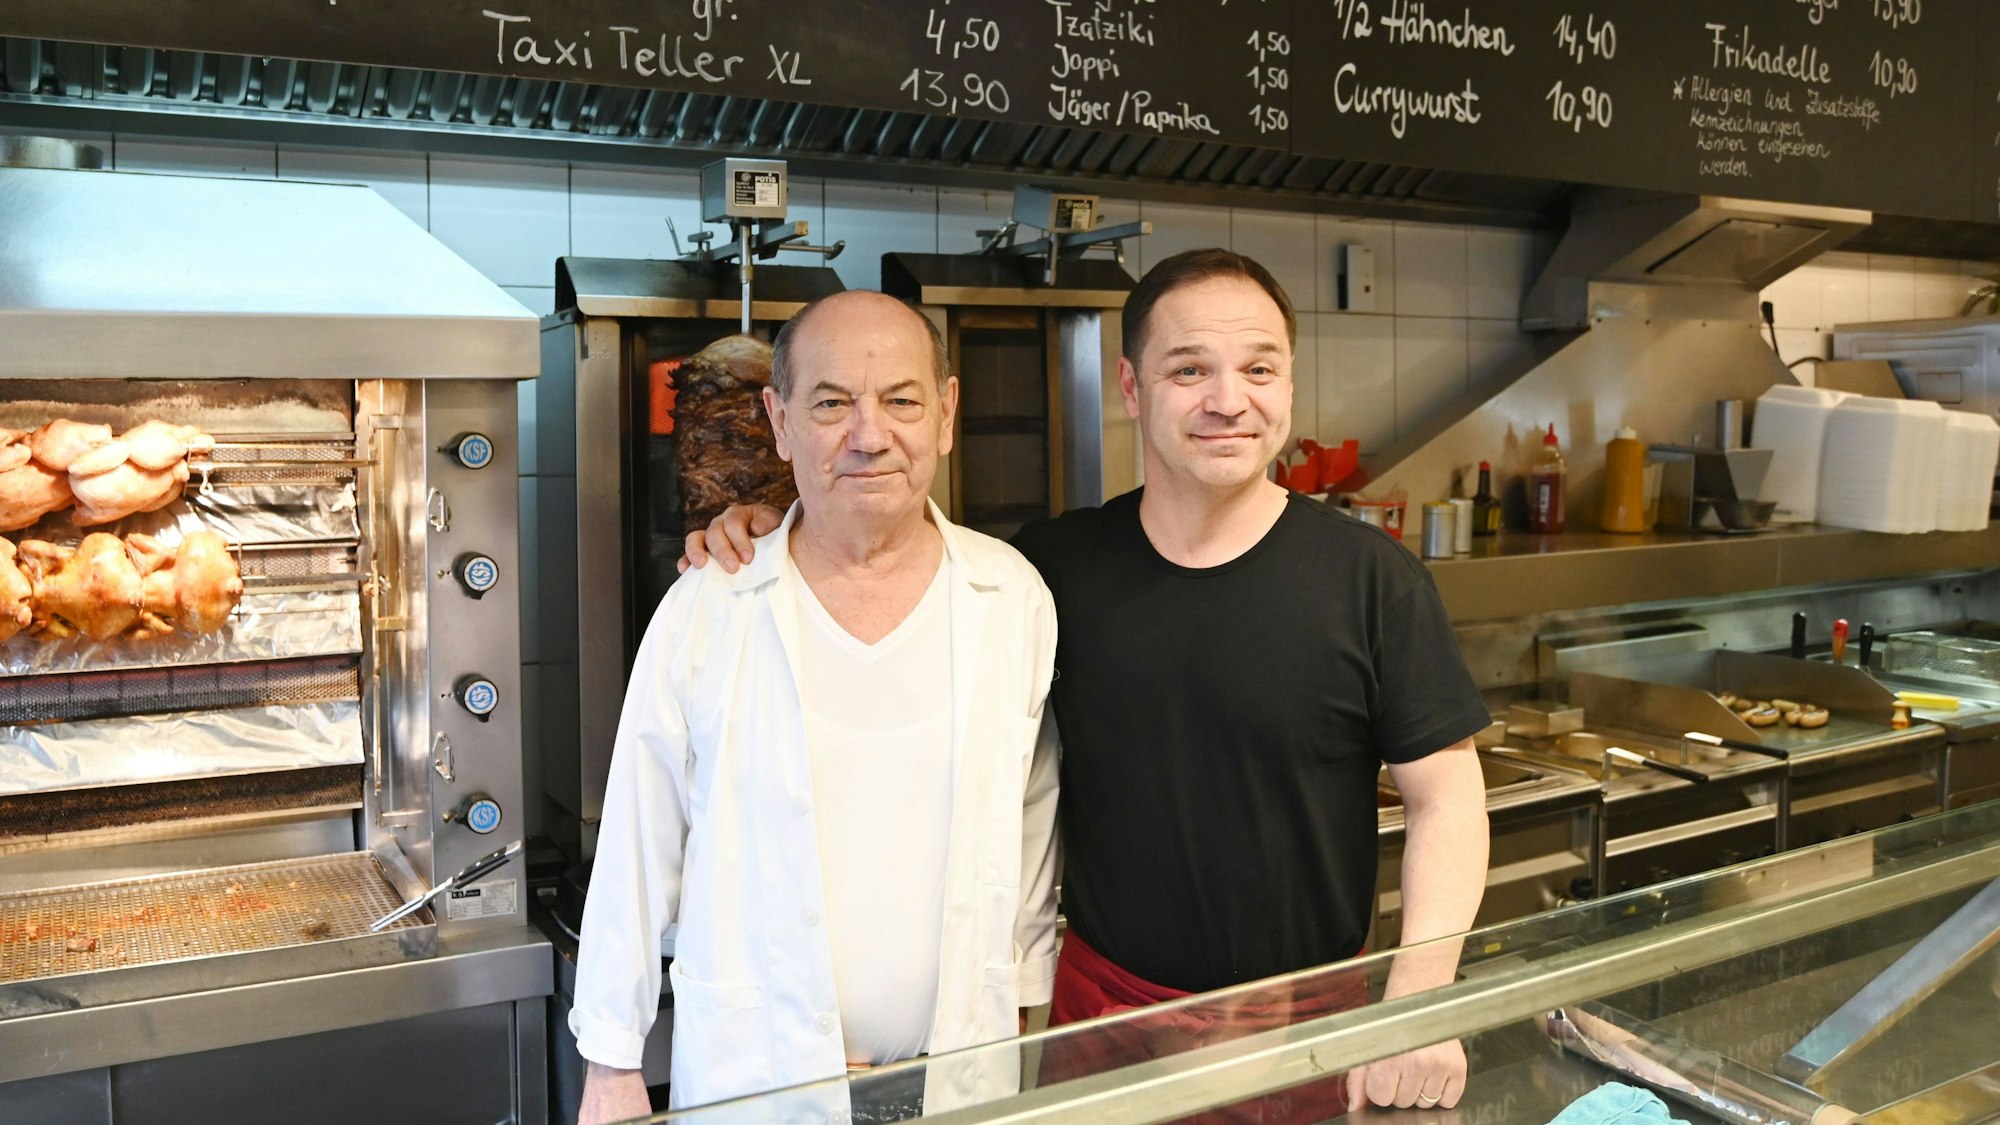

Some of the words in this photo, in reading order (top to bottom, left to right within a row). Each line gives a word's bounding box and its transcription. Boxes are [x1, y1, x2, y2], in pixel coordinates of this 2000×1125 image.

[482, 9, 592, 70] Taxi
[609, 26, 744, 83] Teller
[767, 44, 812, 85] XL
[900, 68, 1010, 114] 13,90
[926, 9, 1000, 59] 4,50
[1045, 0, 1154, 46] Tzatziki
[1247, 30, 1290, 63] 1,50
[1380, 0, 1515, 56] Hähnchen
[1553, 13, 1616, 64] 14,40
[1705, 22, 1832, 84] Frikadelle
[1869, 50, 1918, 98] 10,90
[1051, 43, 1120, 82] Joppi
[1246, 66, 1289, 96] 1,50
[1334, 62, 1481, 139] Currywurst
[1545, 80, 1613, 133] 10,90
[1690, 76, 1752, 115] Allergien
[1248, 104, 1289, 134] 1,50
